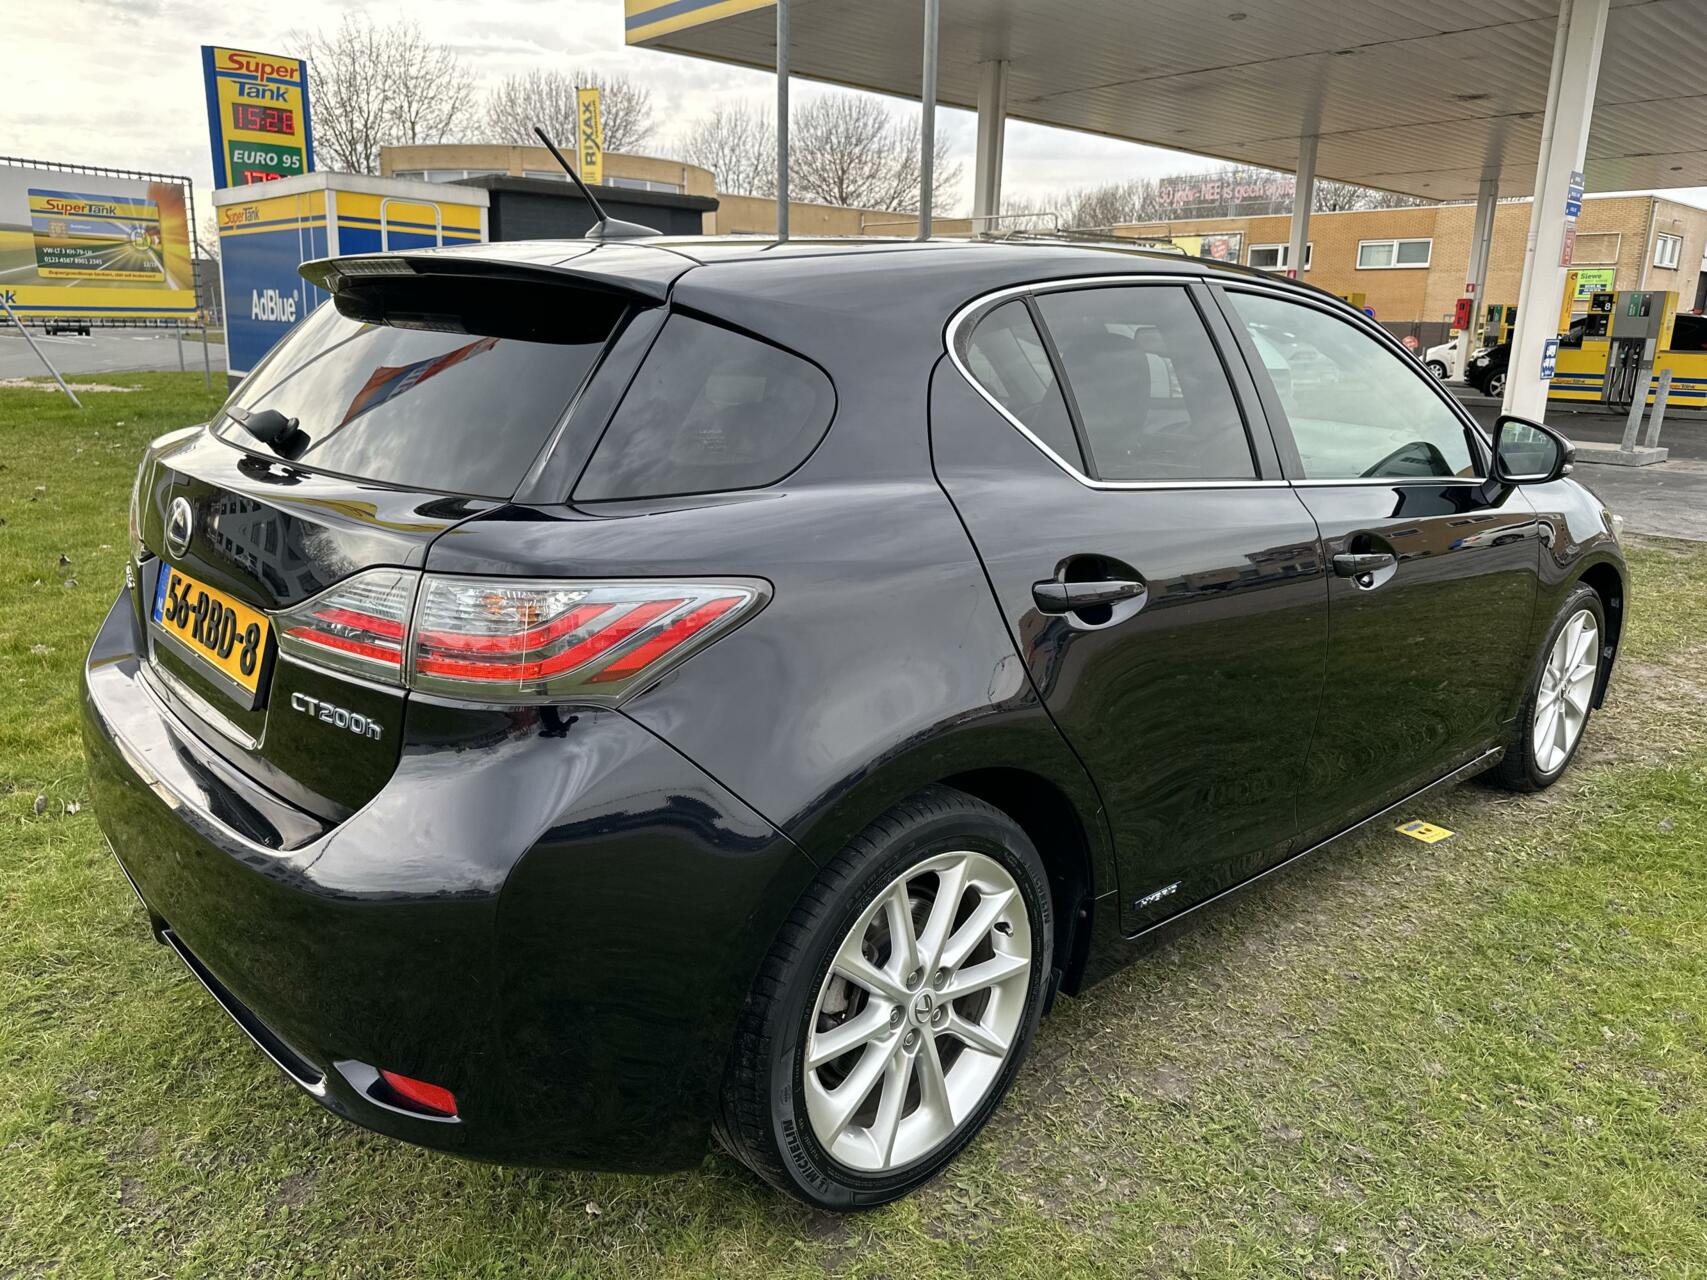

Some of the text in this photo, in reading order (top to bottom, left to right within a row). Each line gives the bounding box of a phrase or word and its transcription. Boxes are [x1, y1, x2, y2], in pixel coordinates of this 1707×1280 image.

[216, 52, 298, 82] Super
[231, 80, 289, 103] Tank
[233, 150, 301, 168] EURO 95
[1201, 181, 1222, 201] NEE
[1222, 181, 1233, 199] is
[1234, 182, 1264, 203] geen
[40, 199, 117, 217] SuperTank
[1604, 302, 1611, 311] 8
[165, 574, 261, 677] 56-RBD-8
[782, 1119, 821, 1184] MICHELIN
